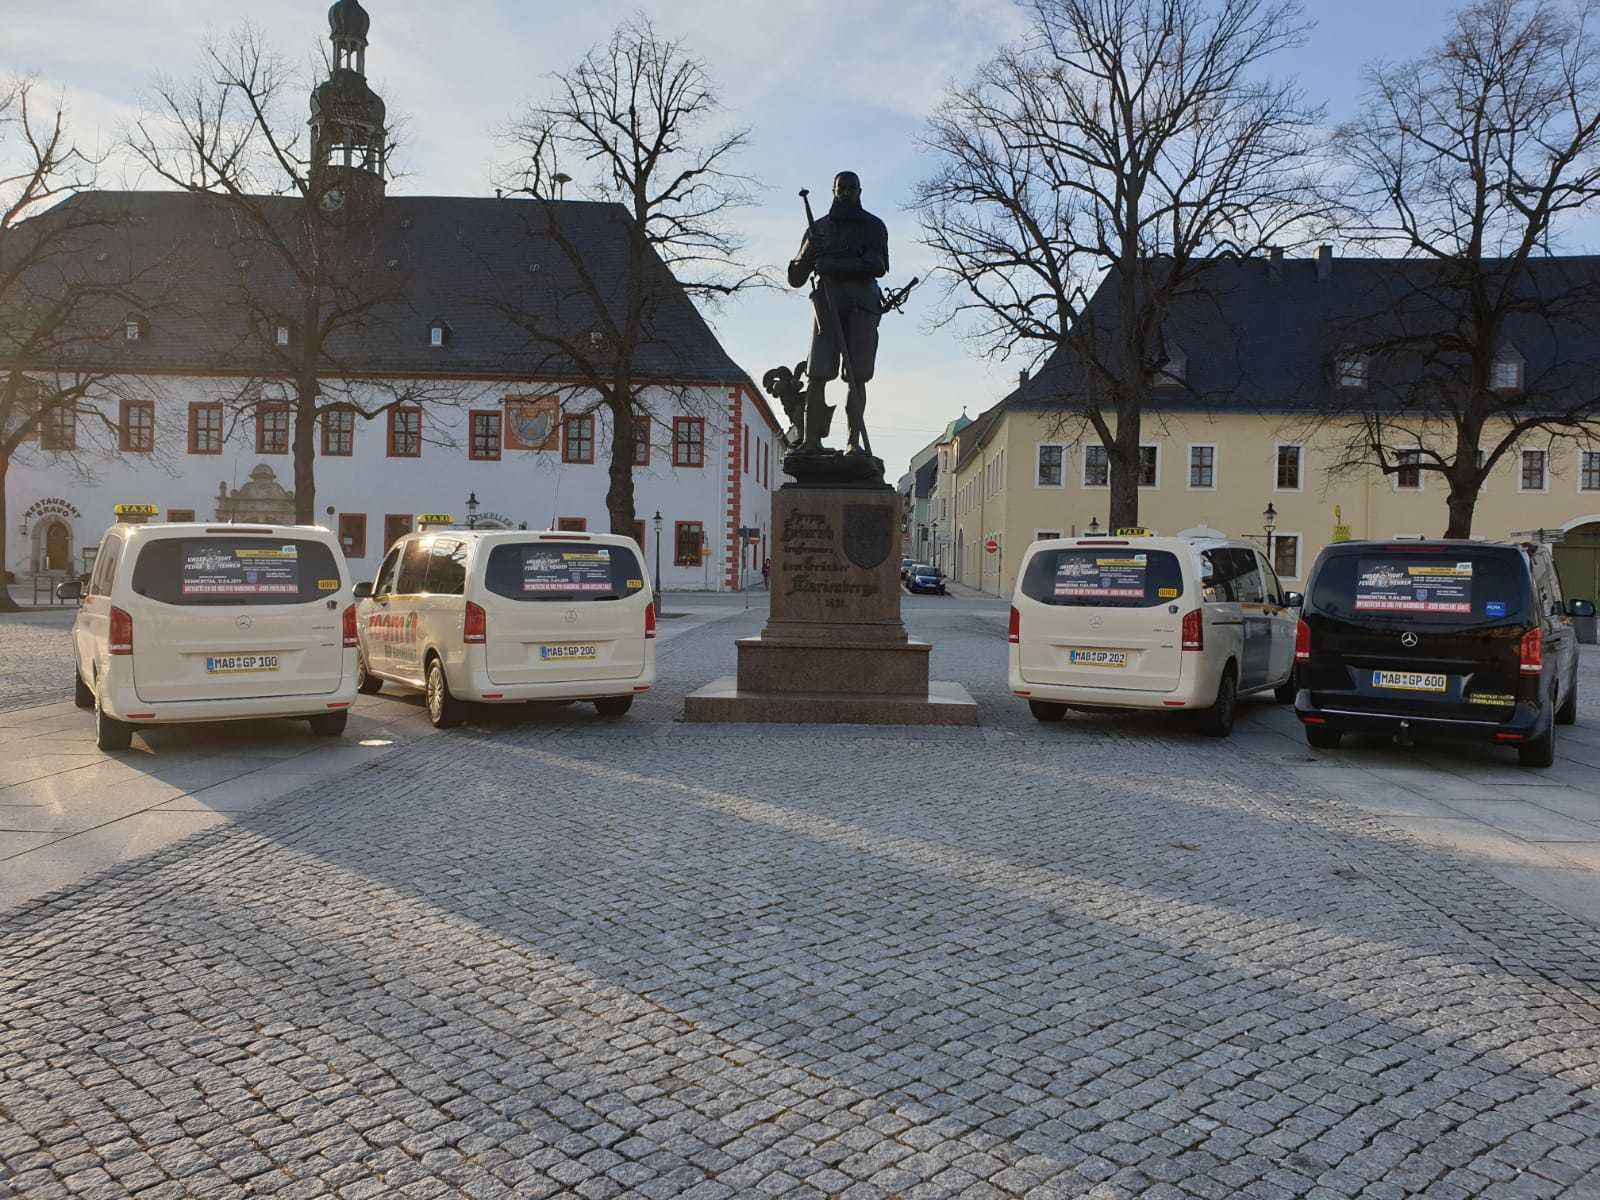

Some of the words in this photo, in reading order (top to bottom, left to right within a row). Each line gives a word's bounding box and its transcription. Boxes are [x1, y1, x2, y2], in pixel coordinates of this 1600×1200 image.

[24, 497, 81, 518] RESTAURANT
[37, 506, 69, 518] BRAVO
[121, 504, 152, 513] TAXI
[581, 646, 595, 656] 200
[258, 656, 277, 667] 100
[1381, 673, 1400, 684] MAB
[1408, 674, 1422, 686] GP
[1424, 675, 1444, 687] 600
